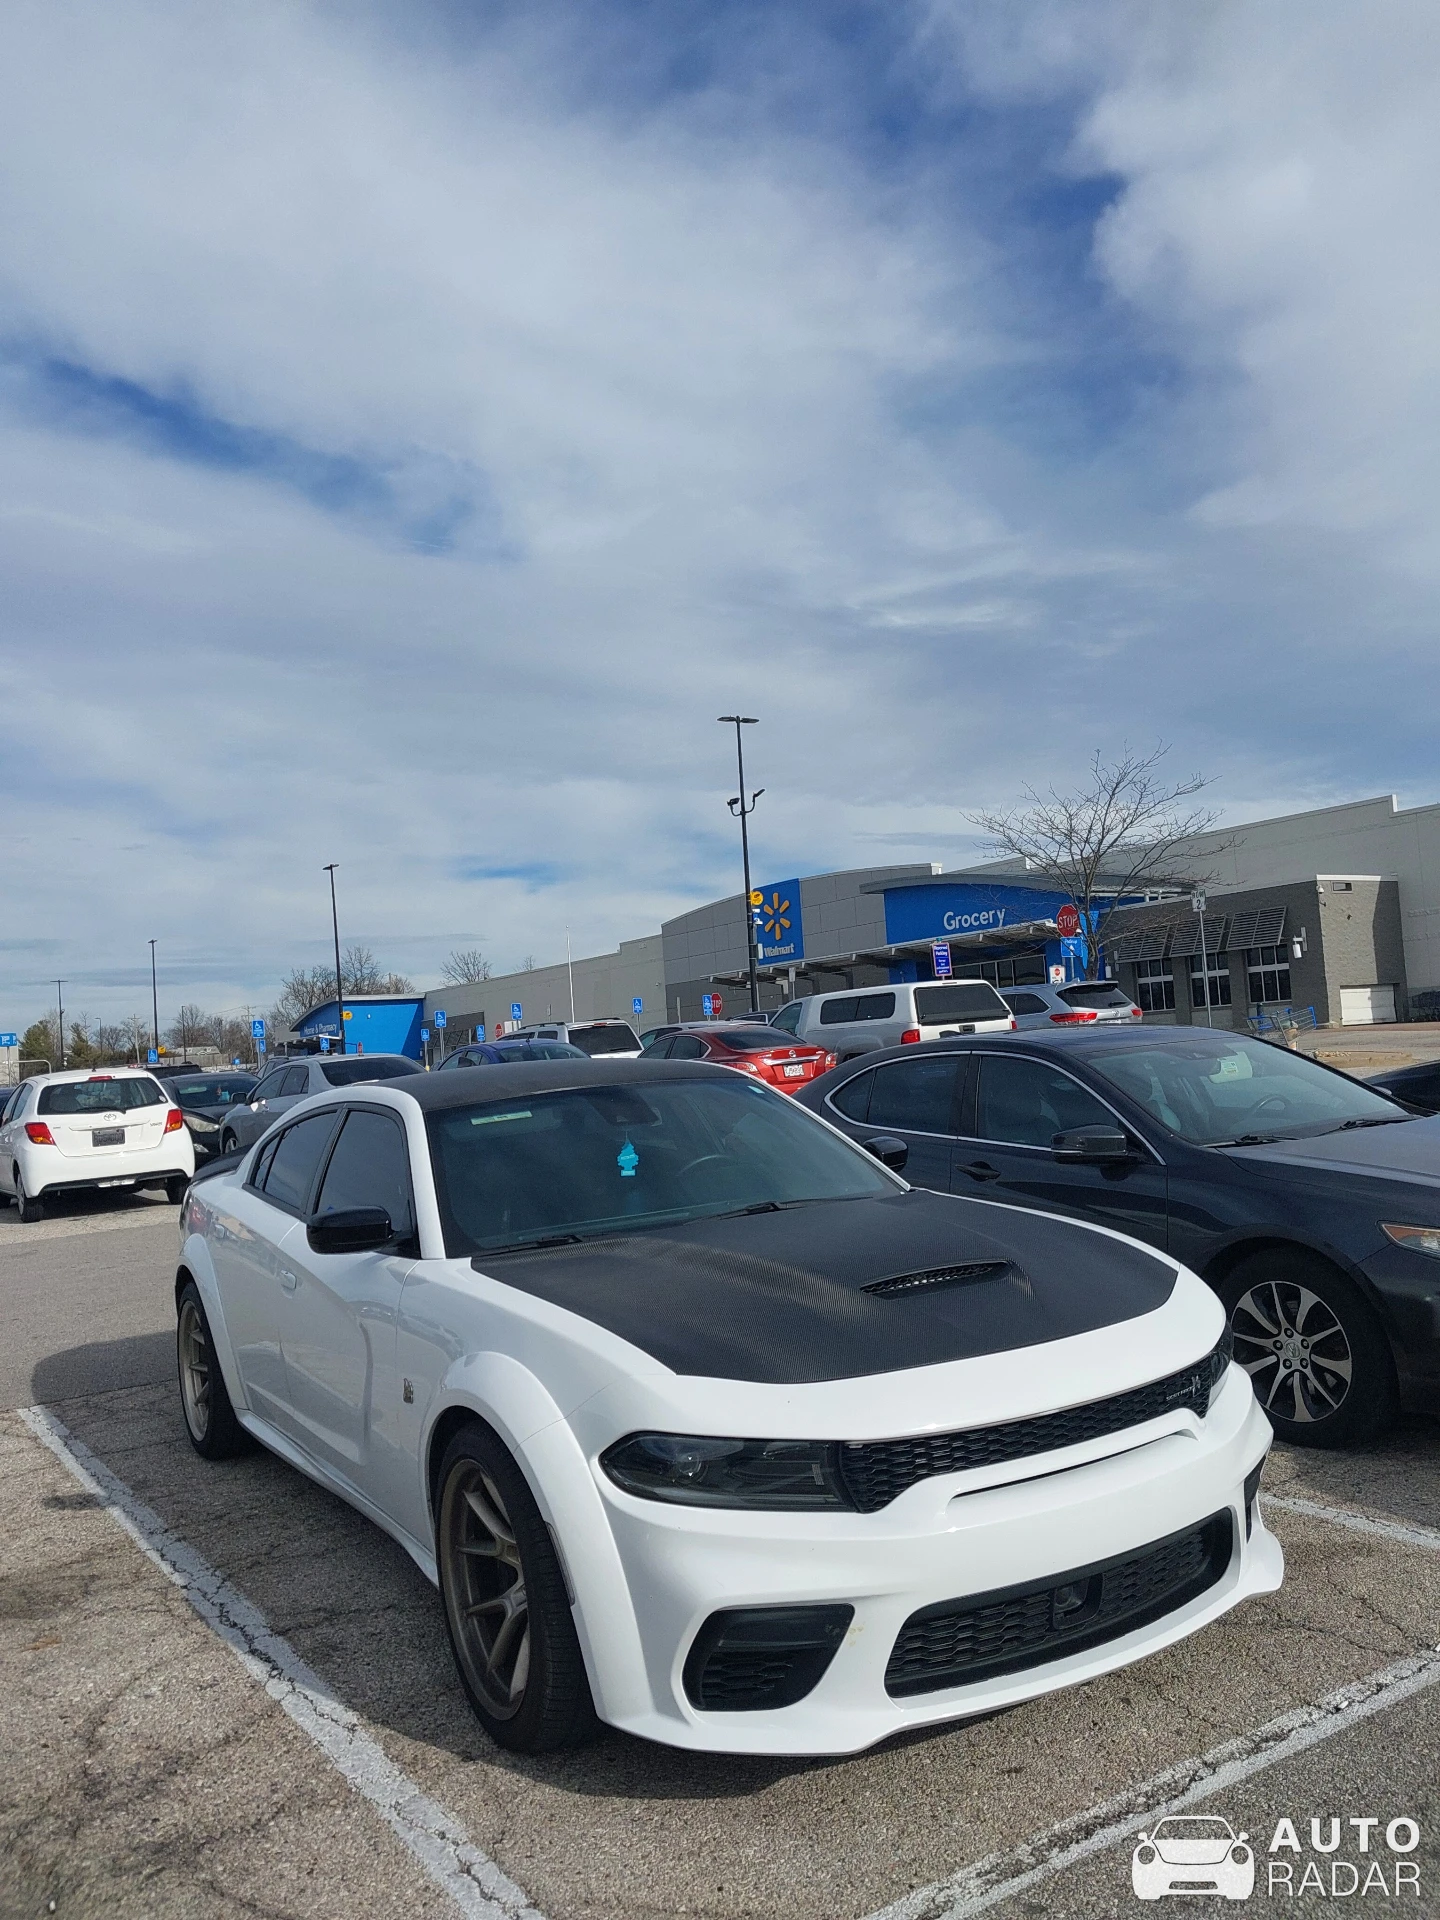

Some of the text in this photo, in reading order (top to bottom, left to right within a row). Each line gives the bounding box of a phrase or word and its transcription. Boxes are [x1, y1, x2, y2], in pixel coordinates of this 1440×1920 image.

[943, 908, 1006, 931] Grocery
[1058, 914, 1078, 929] STOP
[764, 943, 794, 957] Walmart
[304, 1026, 314, 1034] Home
[319, 1023, 337, 1033] Pharmacy
